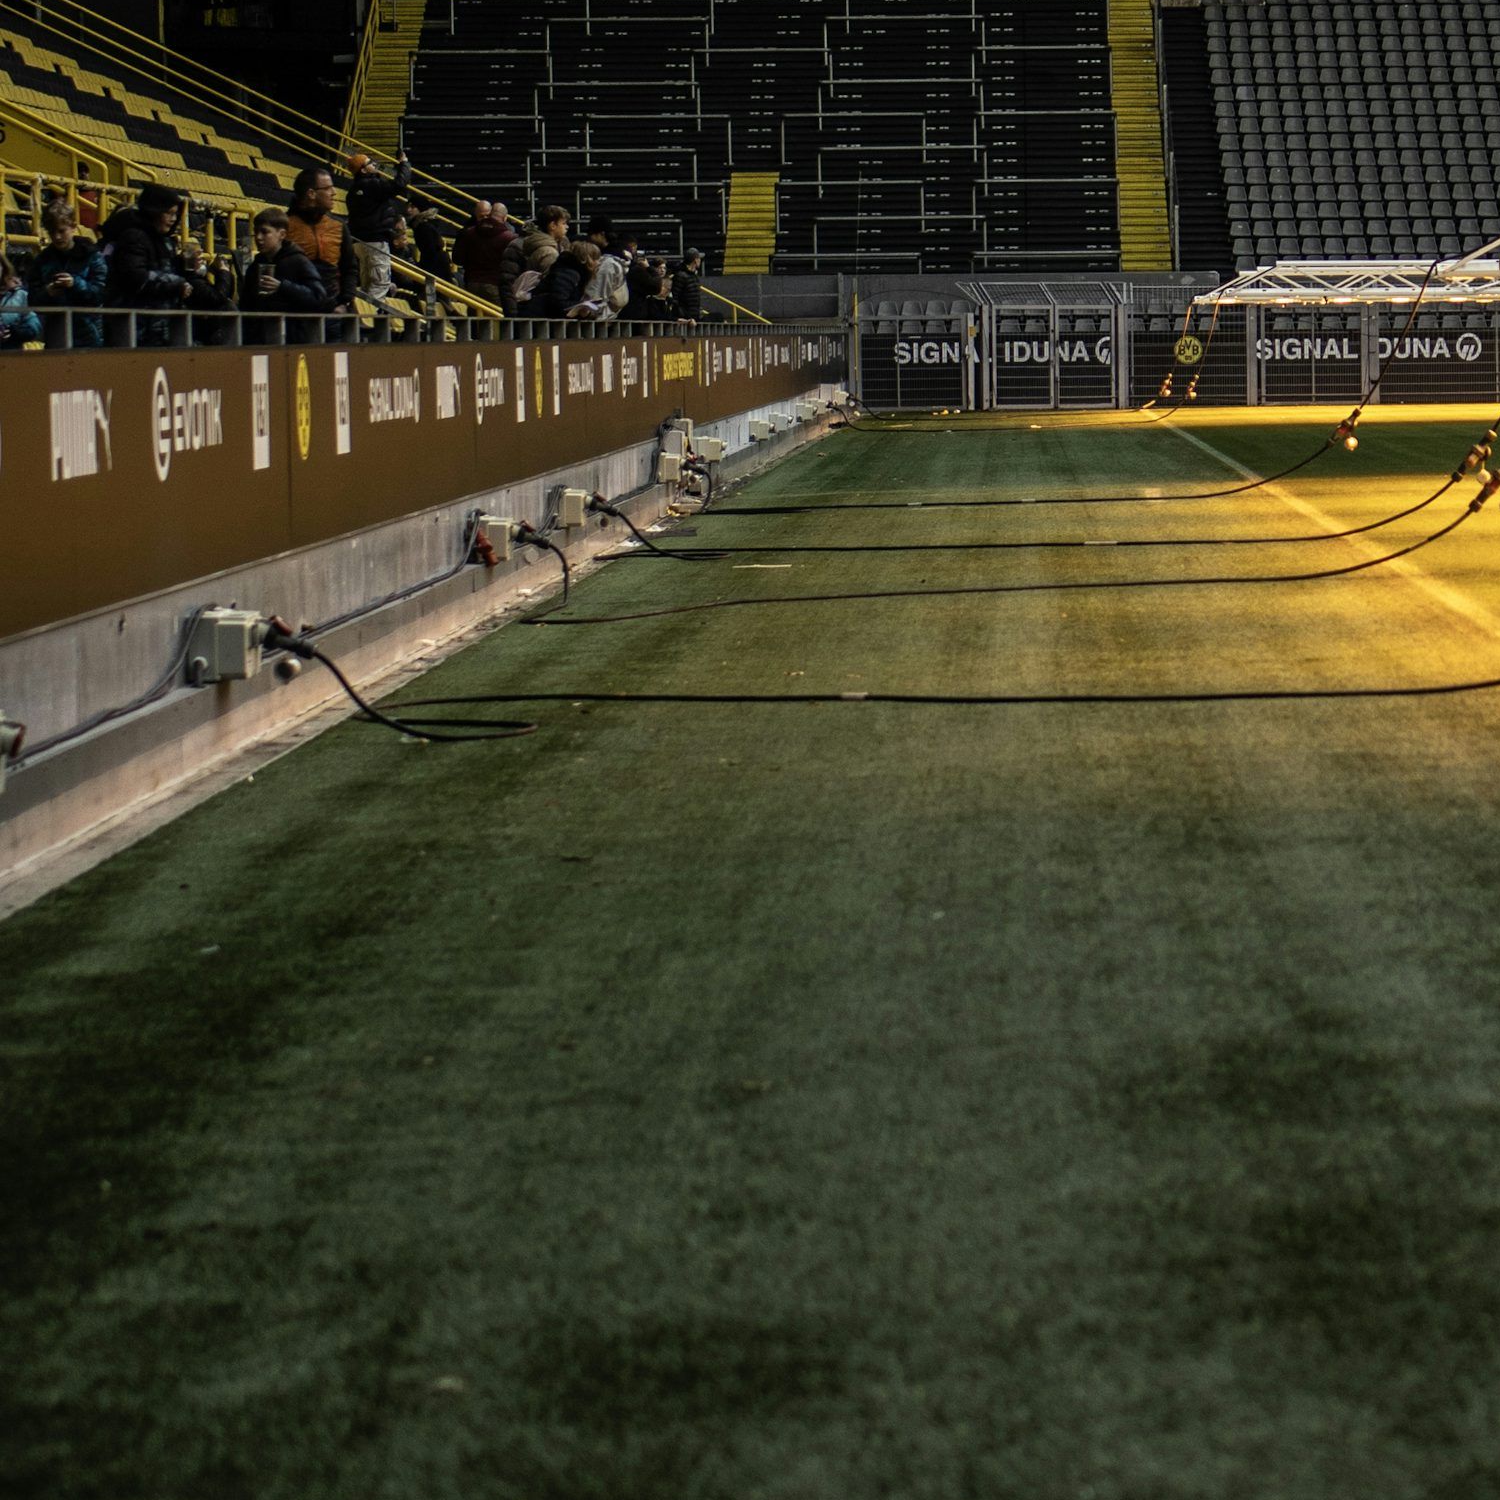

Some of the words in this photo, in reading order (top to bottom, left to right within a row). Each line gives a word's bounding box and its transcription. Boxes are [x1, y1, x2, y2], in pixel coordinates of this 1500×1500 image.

[1004, 340, 1090, 363] IDUNA
[1178, 339, 1199, 356] BVB
[1256, 337, 1359, 360] SIGNAL
[1377, 337, 1451, 359] DUNA
[174, 388, 223, 452] EVONIK
